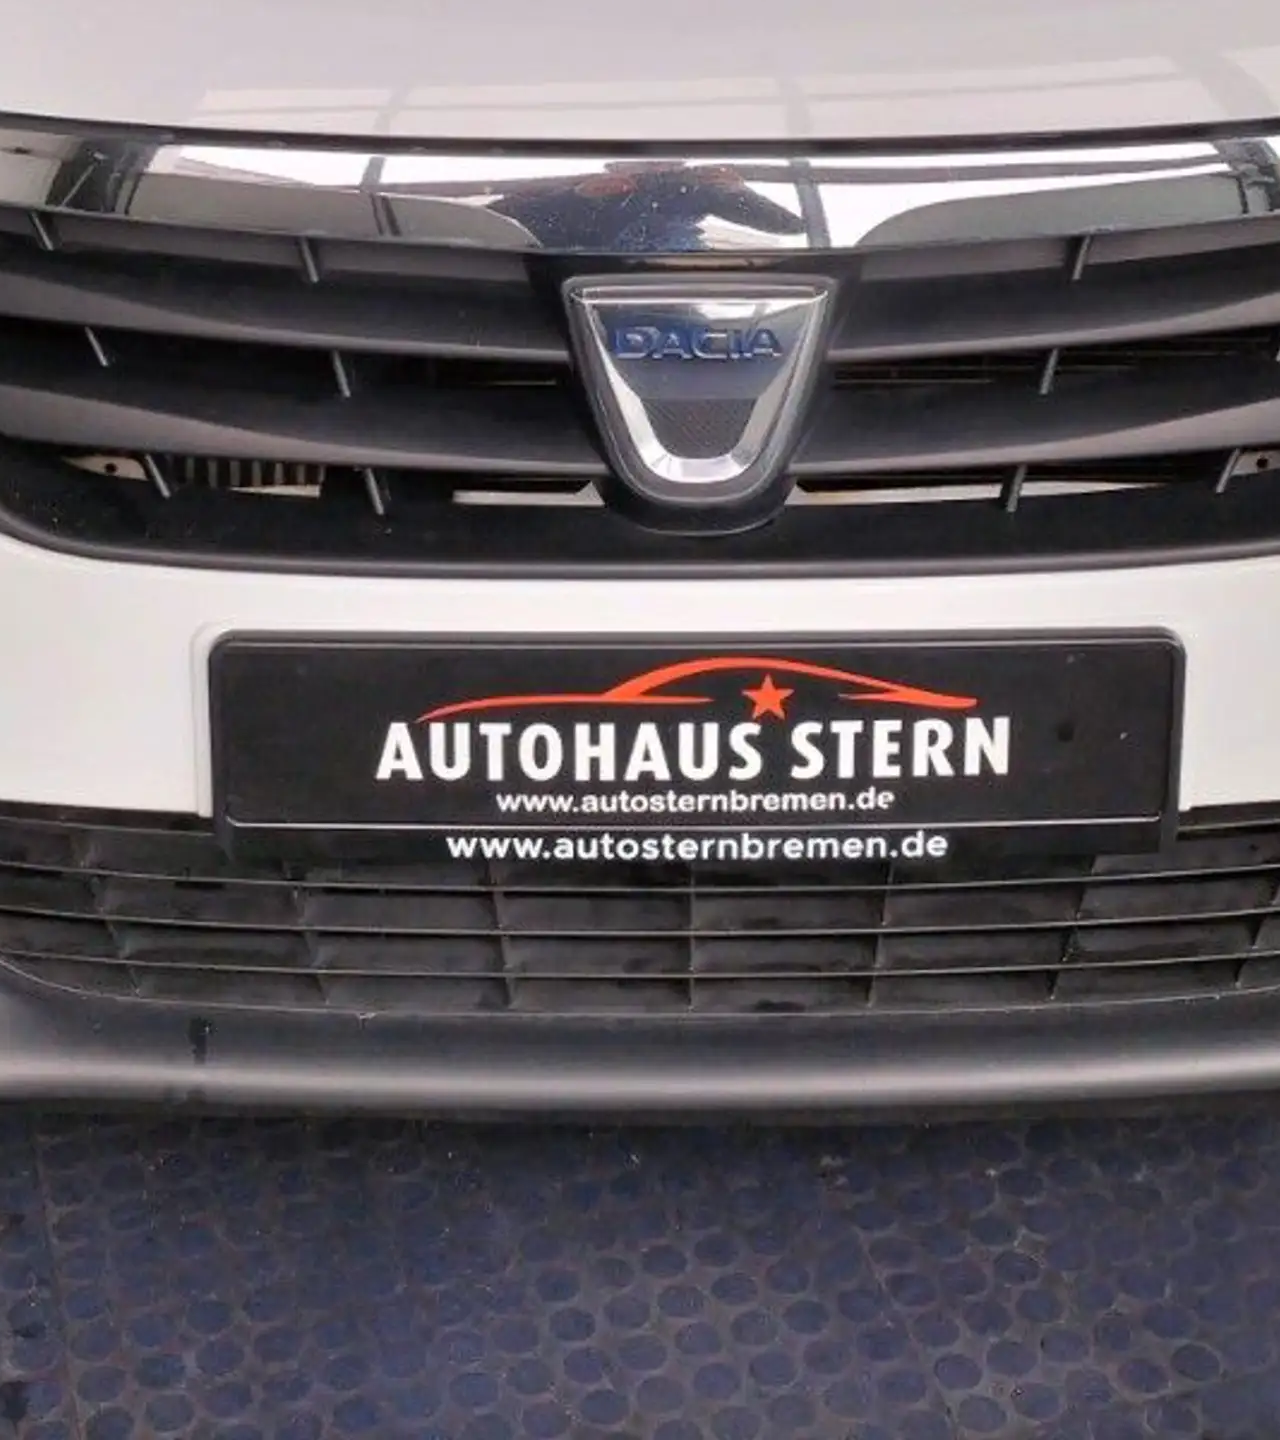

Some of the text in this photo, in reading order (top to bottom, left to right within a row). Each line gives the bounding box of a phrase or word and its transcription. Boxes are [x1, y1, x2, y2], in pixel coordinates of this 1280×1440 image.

[614, 326, 783, 360] DACIA
[375, 716, 1011, 782] AUTOHAUS STERN
[495, 786, 896, 813] www.autosternbremen.de
[445, 831, 949, 860] www.autosternbremen.de
